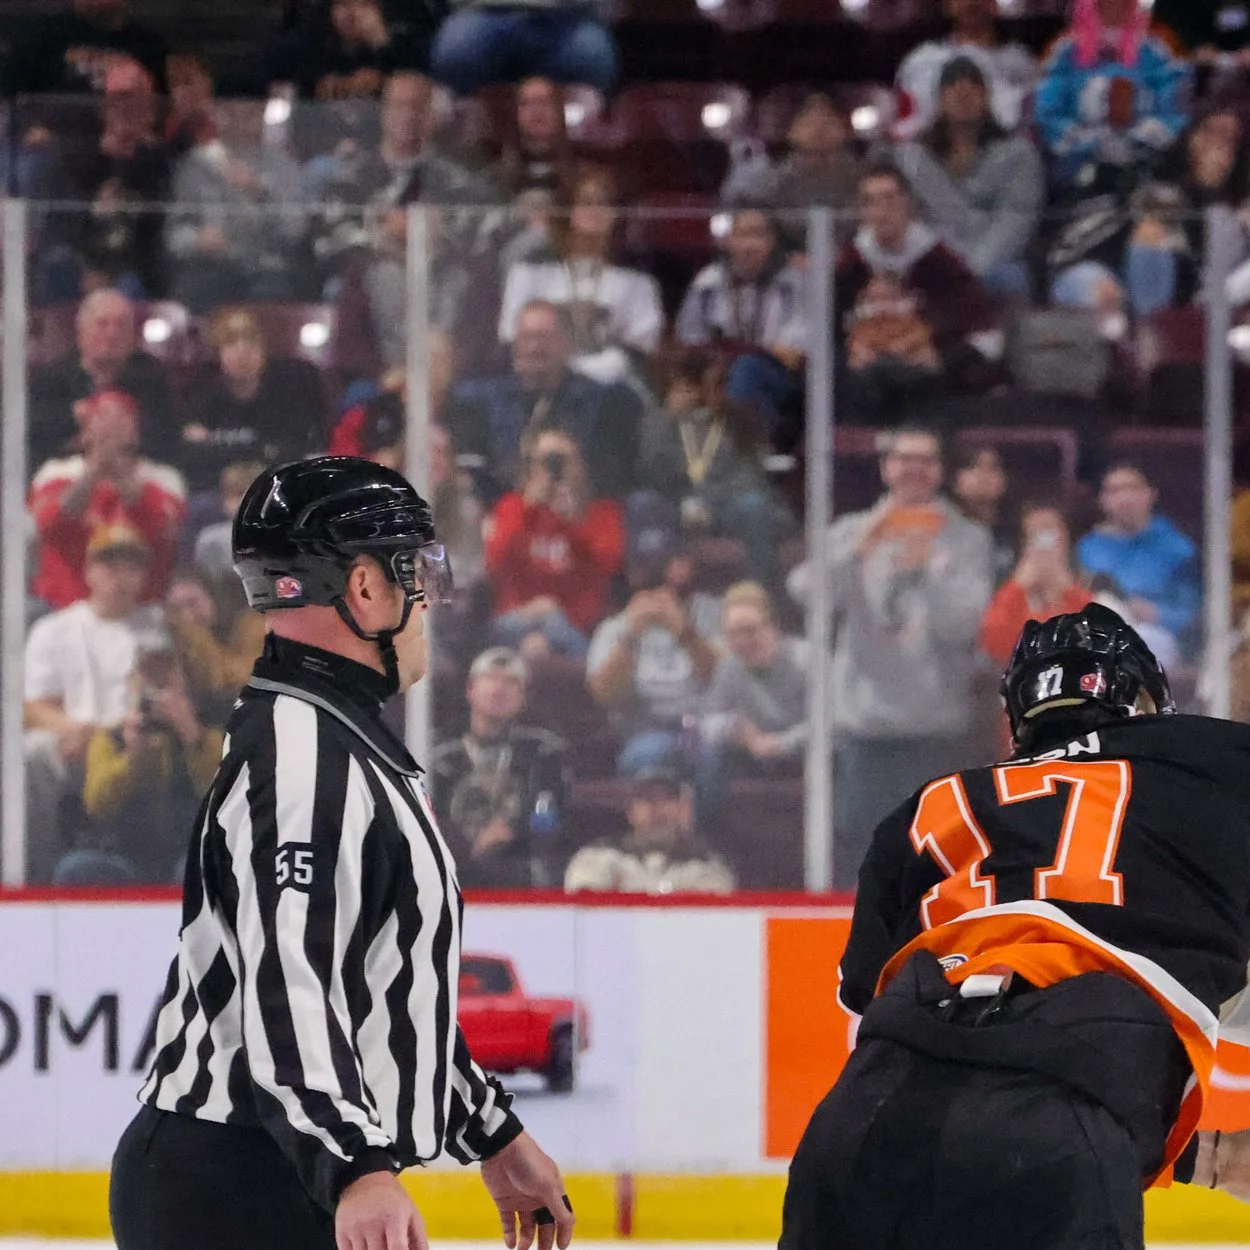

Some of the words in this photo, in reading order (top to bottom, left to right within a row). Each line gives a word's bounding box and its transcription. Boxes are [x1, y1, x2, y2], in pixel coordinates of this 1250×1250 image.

[1037, 664, 1064, 700] 17
[909, 758, 1132, 930] 17
[275, 849, 314, 886] 55
